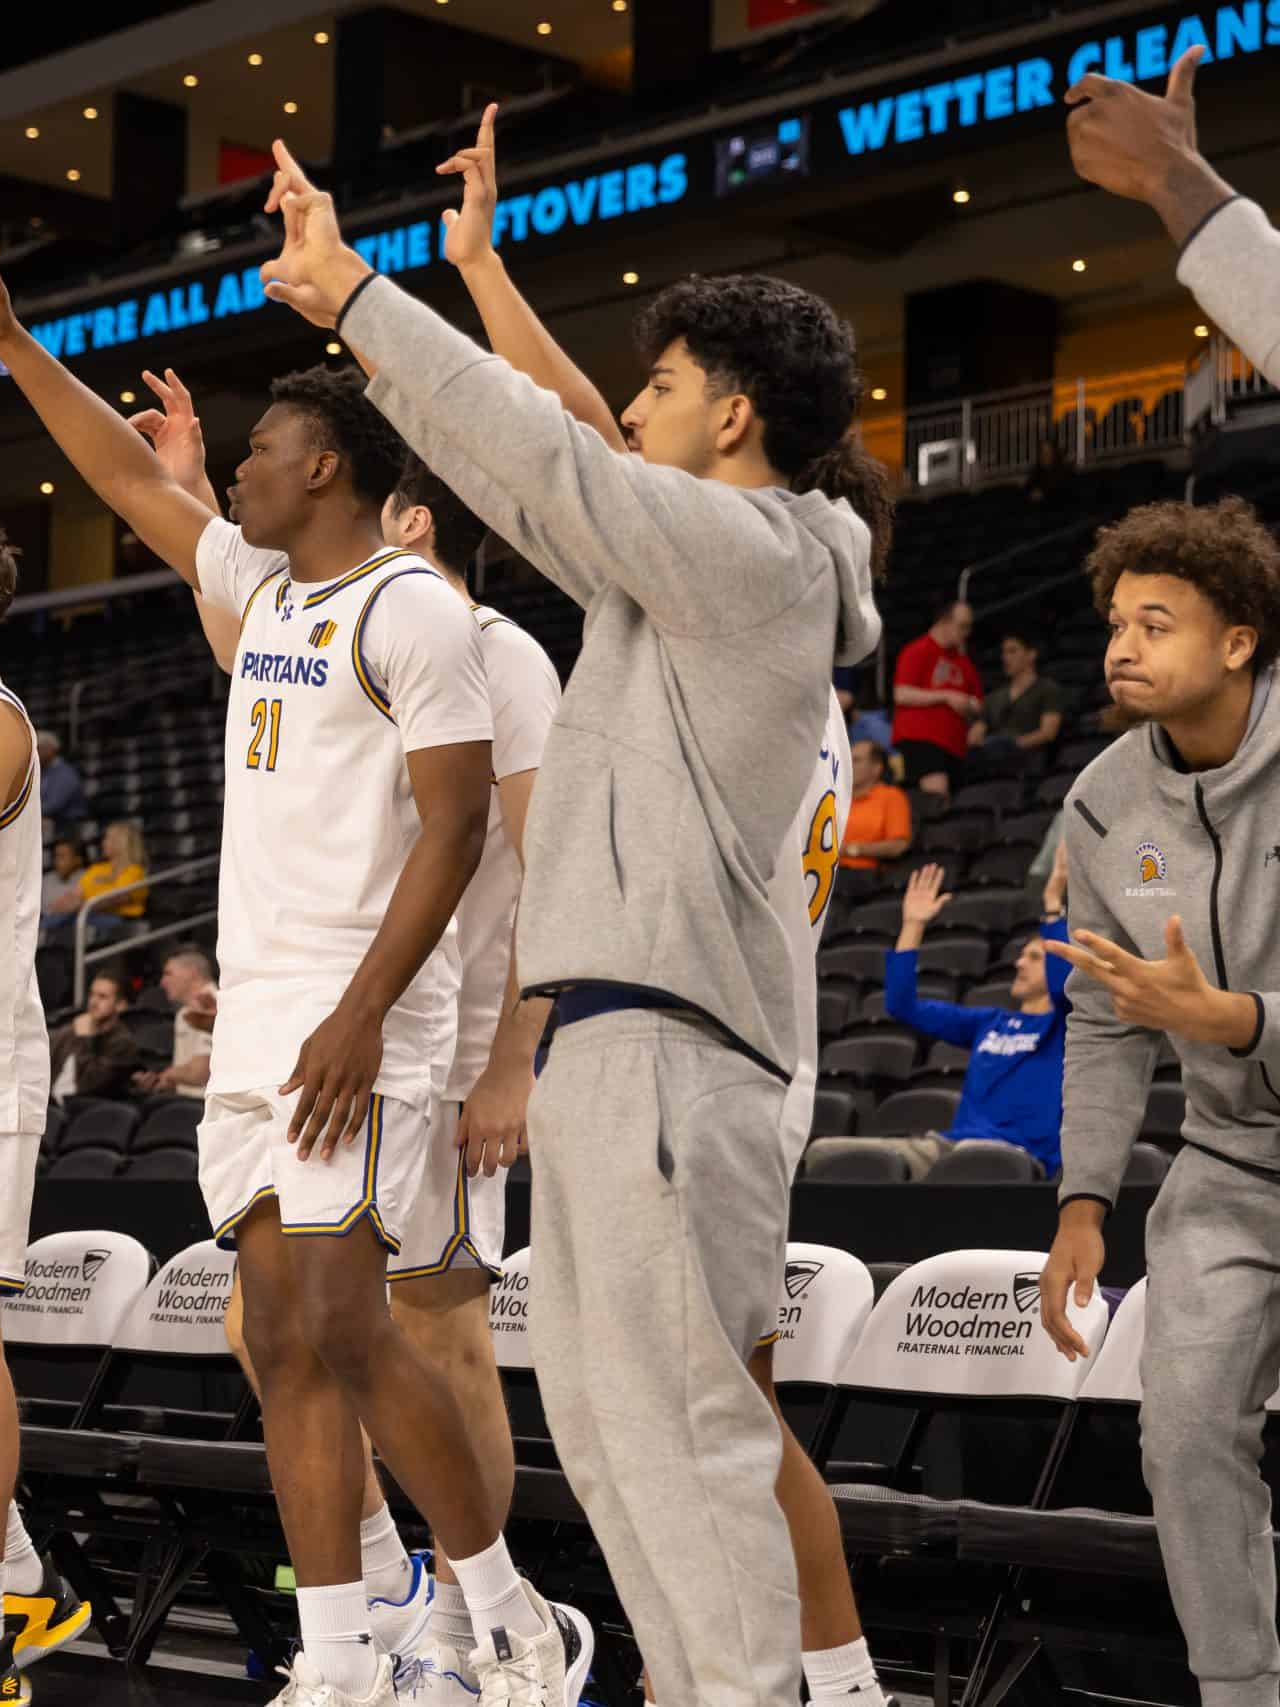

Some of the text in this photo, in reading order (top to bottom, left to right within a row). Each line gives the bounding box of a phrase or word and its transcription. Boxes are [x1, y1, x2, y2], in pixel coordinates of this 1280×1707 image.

[838, 56, 1055, 155] WETTER
[30, 299, 140, 358] WE'RE
[141, 282, 210, 337] ALL
[352, 220, 432, 275] THE
[439, 152, 689, 261] FTOVERS
[241, 652, 328, 686] PARTANS
[247, 698, 282, 771] 21
[23, 1258, 81, 1279] Modern
[163, 1266, 229, 1288] Modern
[4, 1302, 84, 1315] FRATERNAL FINANCIAL
[157, 1288, 232, 1311] Woodme
[910, 1285, 1008, 1310] Modern
[149, 1312, 225, 1325] FRATERNAL FINANC
[905, 1312, 1033, 1339] Woodmen
[896, 1342, 1026, 1356] FRATERNAL FINANCIAL
